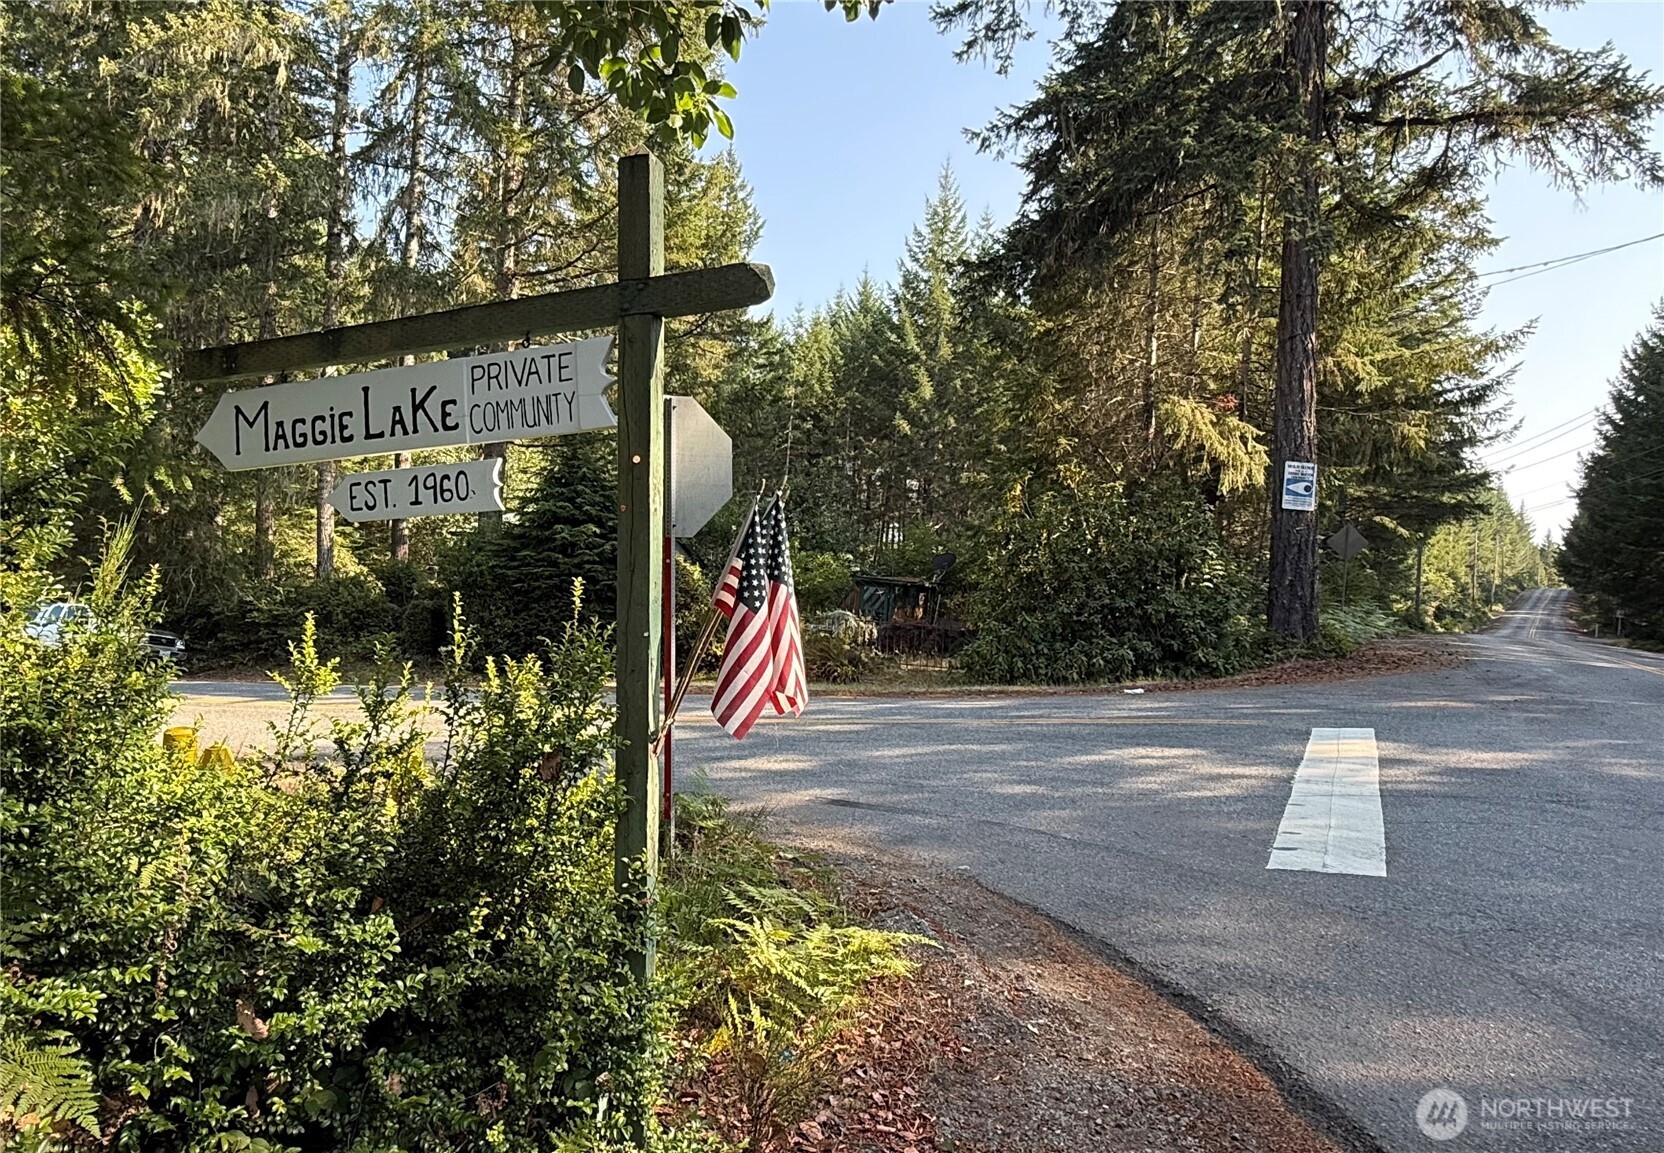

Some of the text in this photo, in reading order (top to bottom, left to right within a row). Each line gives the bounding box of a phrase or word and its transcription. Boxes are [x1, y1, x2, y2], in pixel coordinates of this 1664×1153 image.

[470, 351, 574, 396] PRIVATE
[469, 390, 576, 435] COMMUNITY
[349, 478, 397, 512] EST.
